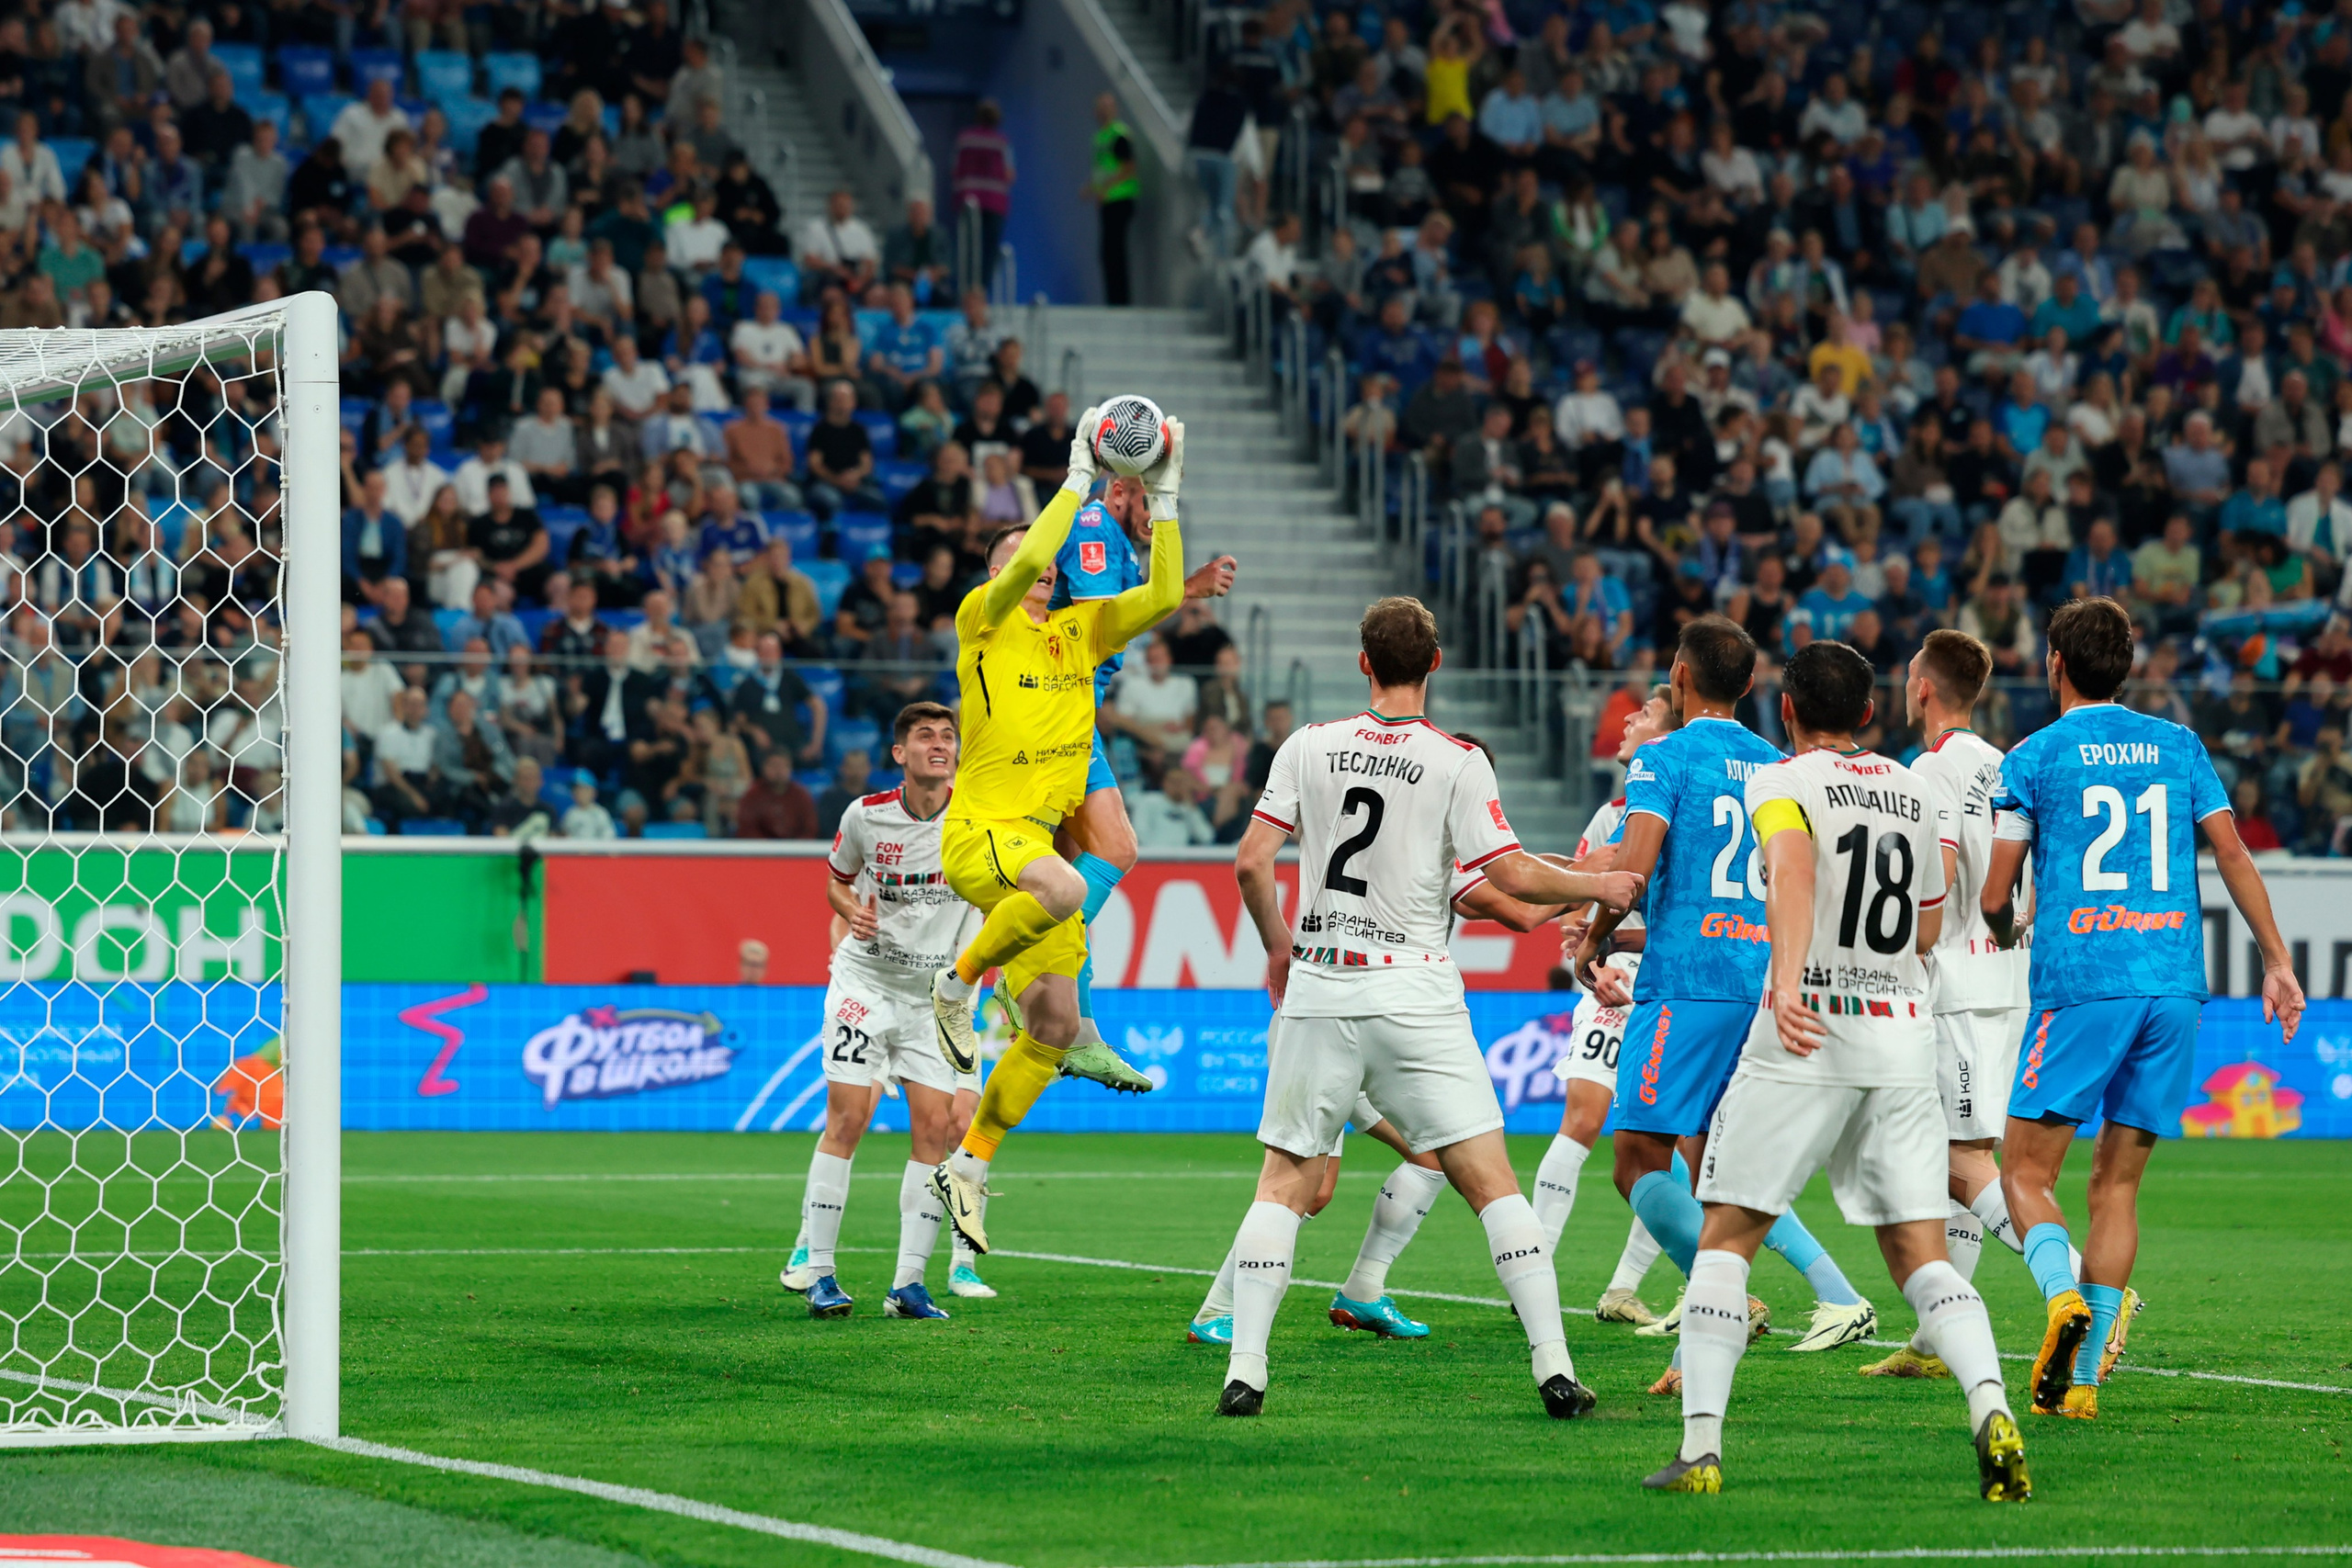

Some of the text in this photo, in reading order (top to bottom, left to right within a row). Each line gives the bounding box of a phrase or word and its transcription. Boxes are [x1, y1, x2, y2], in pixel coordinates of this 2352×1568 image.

[1080, 512, 1101, 523] wb
[1354, 728, 1413, 746] FONBET
[2078, 742, 2159, 766] ЕРОХИН
[1326, 750, 1425, 785] ТЕСЛЕНКО
[1834, 761, 1892, 776] FONBET
[1825, 784, 1921, 823] АПШАЦЕВ
[876, 841, 904, 854] FON
[1325, 786, 1385, 897] 2
[2082, 784, 2169, 892] 21
[876, 853, 904, 866] BET
[1836, 823, 1915, 955] 18
[1328, 910, 1377, 929] АЗАНЬ
[1328, 921, 1406, 943] РГСИНТЕЗ
[1838, 964, 1898, 984] КАЗАНЬ
[836, 1007, 865, 1026] BET
[842, 998, 870, 1018] FON
[1596, 1005, 1626, 1023] FON
[1592, 1015, 1623, 1030] BET
[831, 1025, 870, 1065] 22
[1581, 1030, 1622, 1069] 90
[1958, 1060, 1971, 1094] КОС
